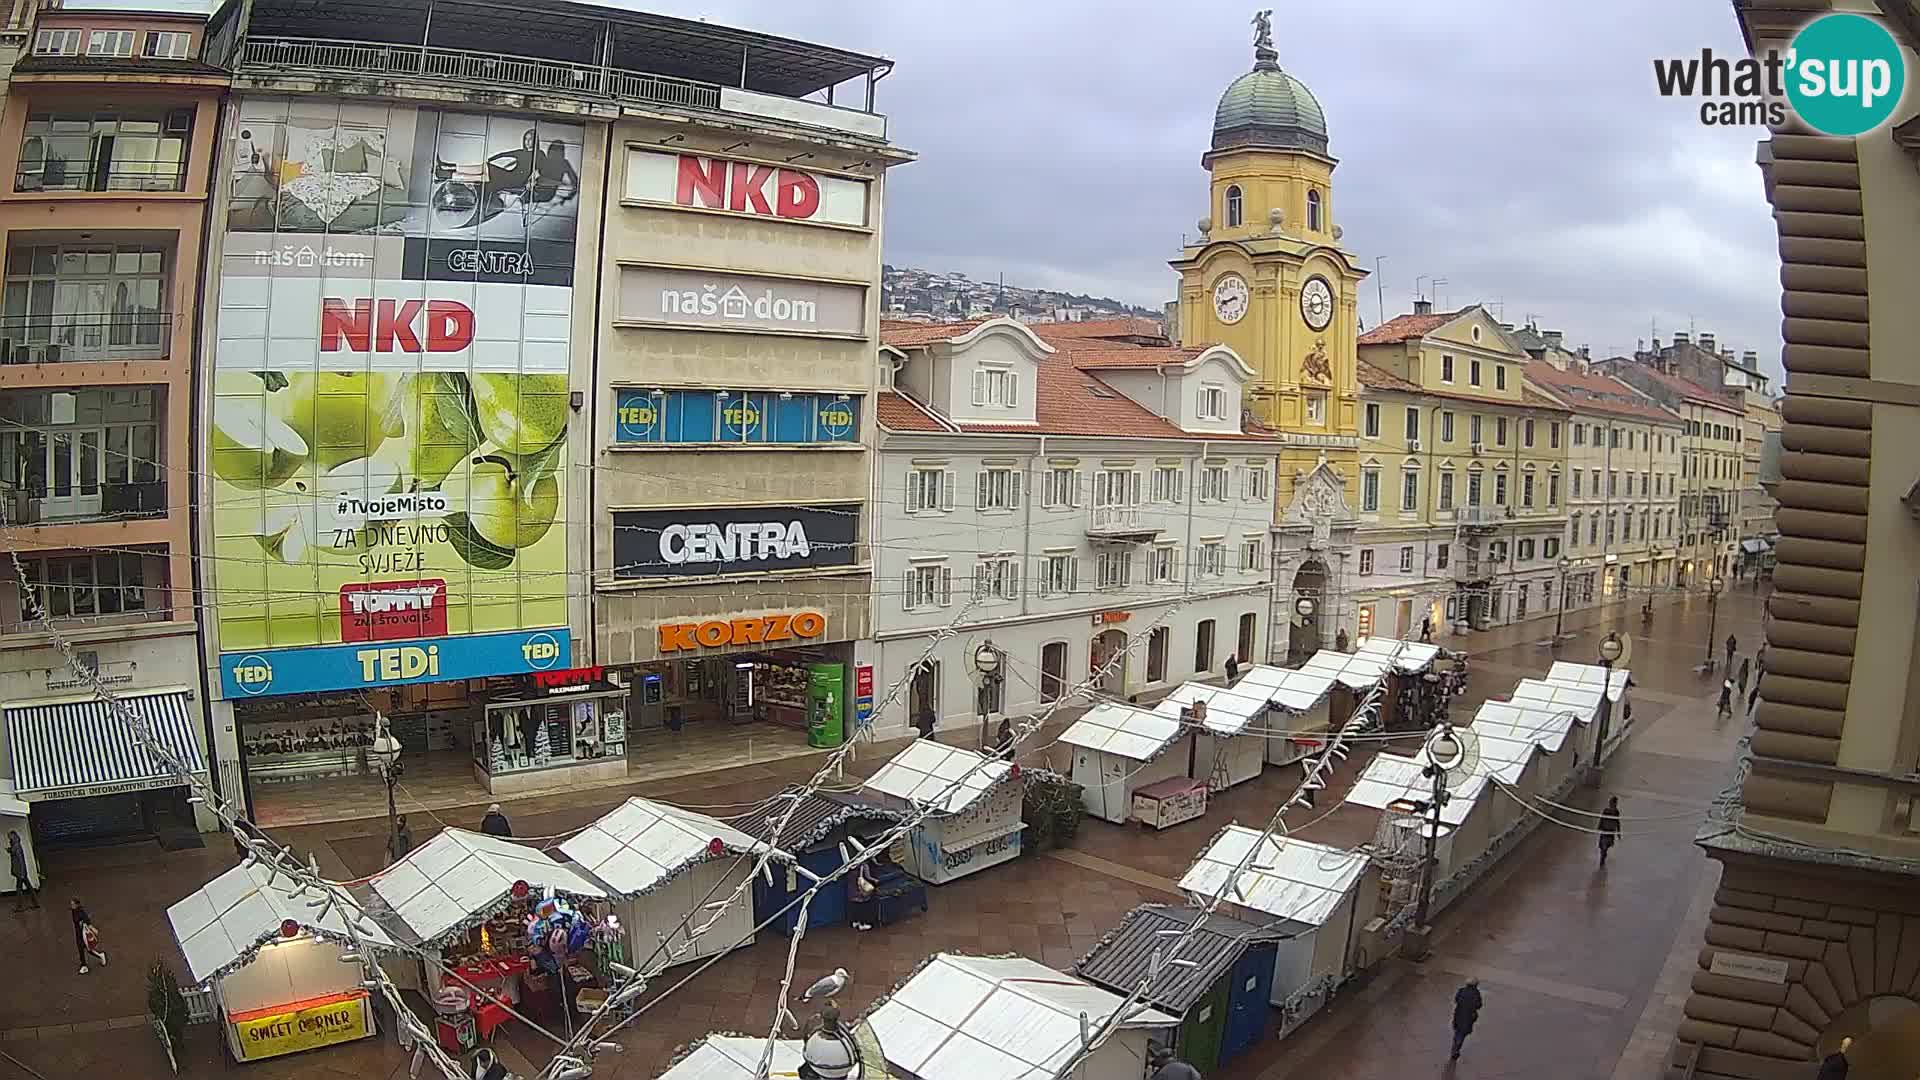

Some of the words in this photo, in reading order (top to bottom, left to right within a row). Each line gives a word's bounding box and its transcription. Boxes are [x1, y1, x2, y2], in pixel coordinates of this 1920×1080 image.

[676, 154, 820, 219] NKD
[254, 245, 294, 265] naš
[319, 246, 365, 266] dom
[447, 249, 534, 275] CENTRA
[661, 283, 718, 315] naš
[754, 289, 816, 322] dom
[320, 297, 476, 353] NKD
[618, 407, 658, 425] TEDi
[723, 408, 760, 426] TEDi
[819, 411, 853, 427] TEDi
[337, 496, 446, 516] #TvojeMisto
[333, 528, 357, 548] ZA
[366, 523, 451, 548] DNEVNO
[658, 520, 811, 564] CENTRA
[358, 547, 425, 575] SVJEŽE
[348, 585, 439, 614] TOMMY
[659, 612, 825, 652] KORZO
[357, 644, 439, 683] TEDi
[521, 642, 560, 661] TEDi
[233, 664, 273, 685] TEDi
[249, 1021, 292, 1041] SWEET
